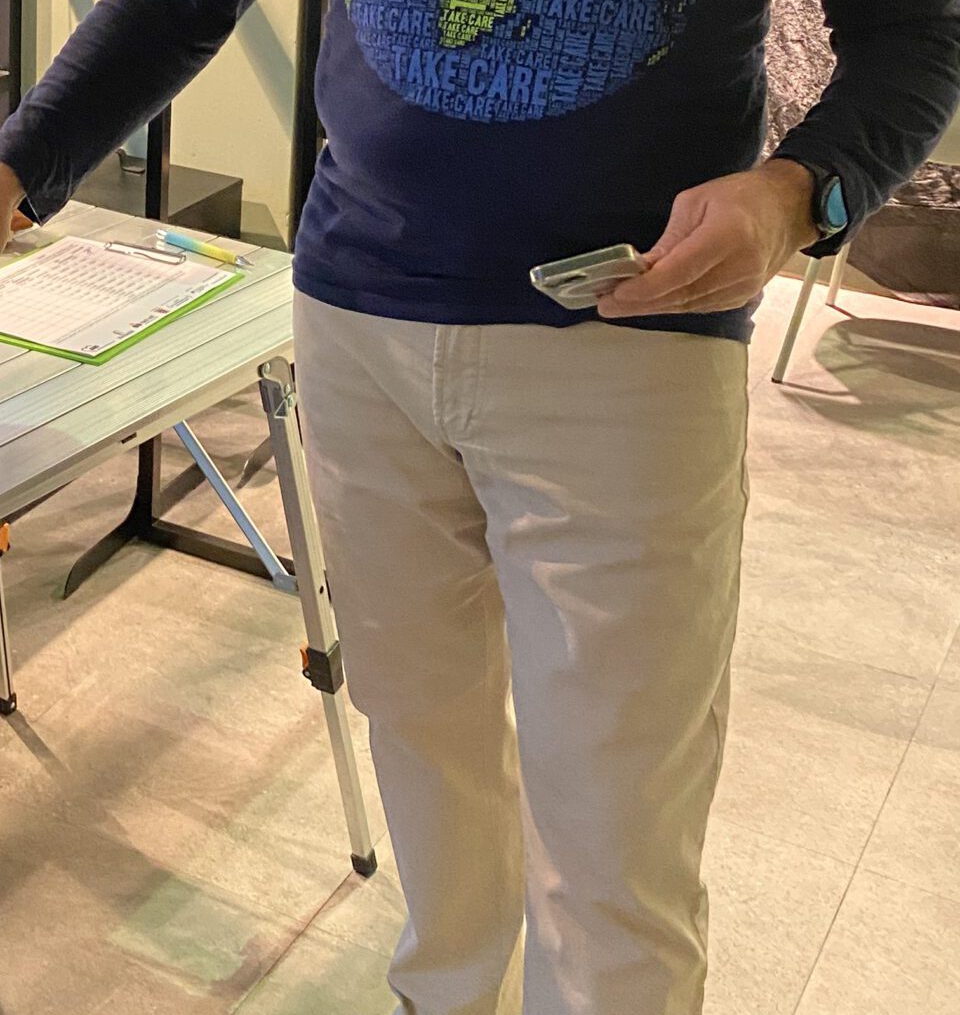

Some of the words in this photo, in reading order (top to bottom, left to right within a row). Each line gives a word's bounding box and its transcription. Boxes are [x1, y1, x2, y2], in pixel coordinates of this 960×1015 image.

[443, 9, 468, 24] TAKE
[468, 13, 494, 29] CARE
[443, 22, 461, 32] TAKE
[461, 24, 478, 35] CARE
[599, 0, 656, 32] CARE
[480, 43, 512, 64] TAKE
[516, 49, 551, 69] CARE
[391, 45, 460, 92] TAKE
[468, 59, 552, 106] CARE
[414, 87, 450, 112] TAKE
[454, 93, 492, 117] CARE
